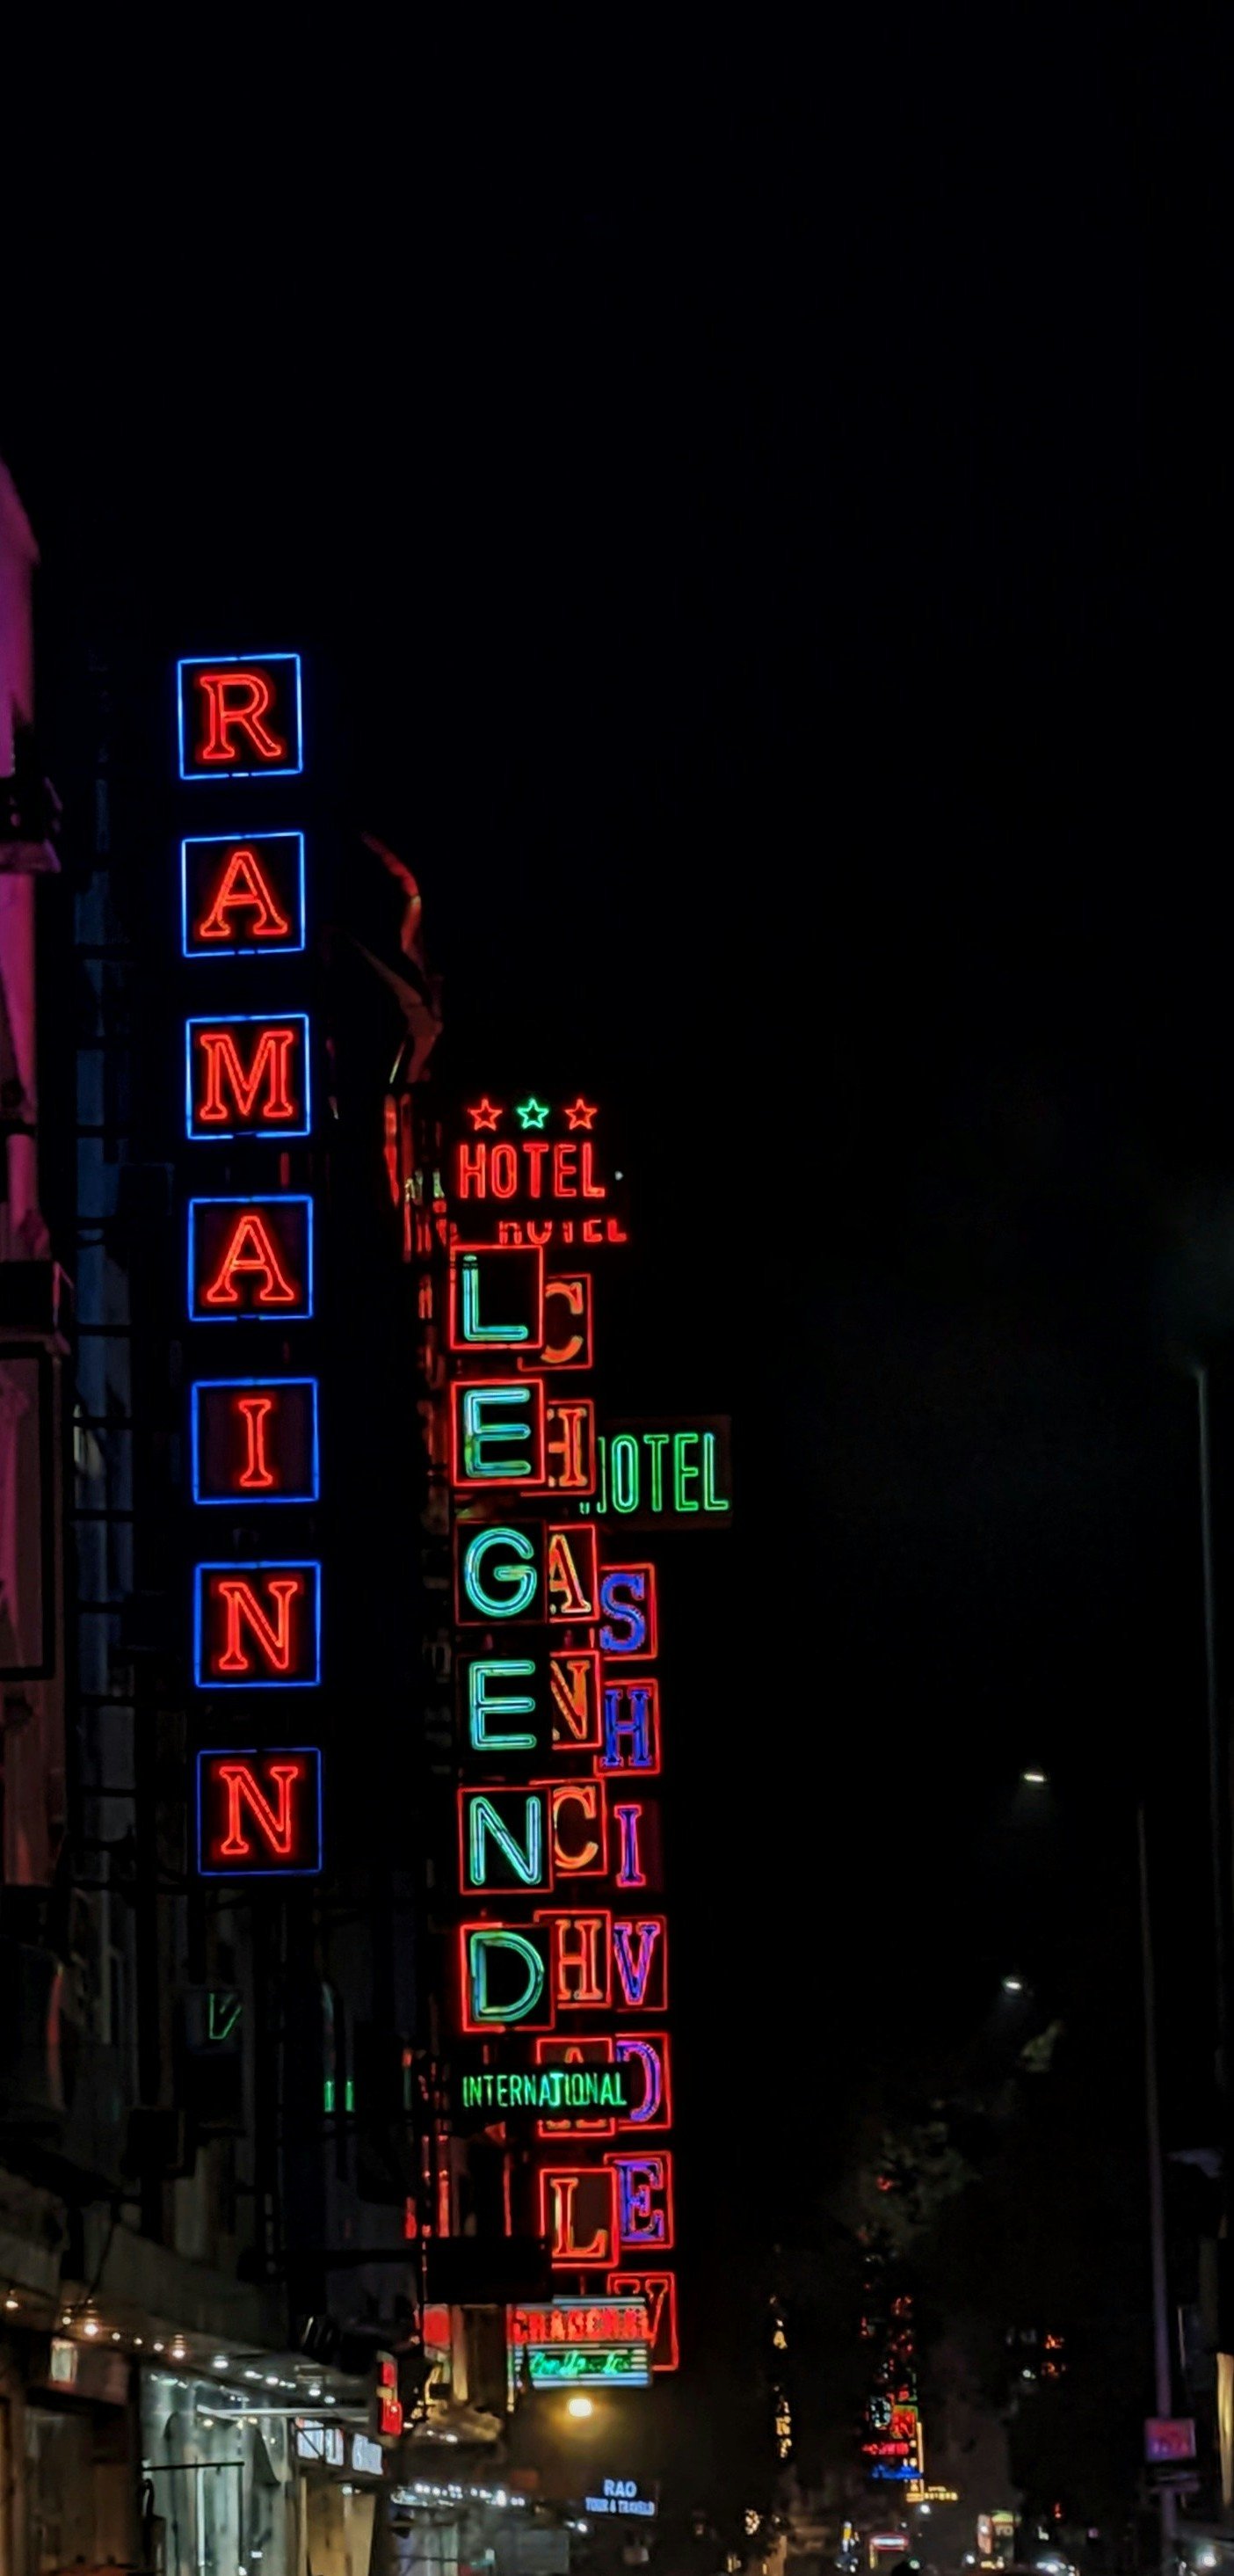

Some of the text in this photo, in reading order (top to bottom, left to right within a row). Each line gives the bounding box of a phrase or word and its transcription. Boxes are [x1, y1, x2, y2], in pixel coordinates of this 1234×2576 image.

[459, 1143, 606, 1199] HOTEL
[461, 1254, 545, 2022] LEGEND
[462, 2071, 628, 2107] INTERNATIONAL
[603, 2478, 638, 2498] RAO
